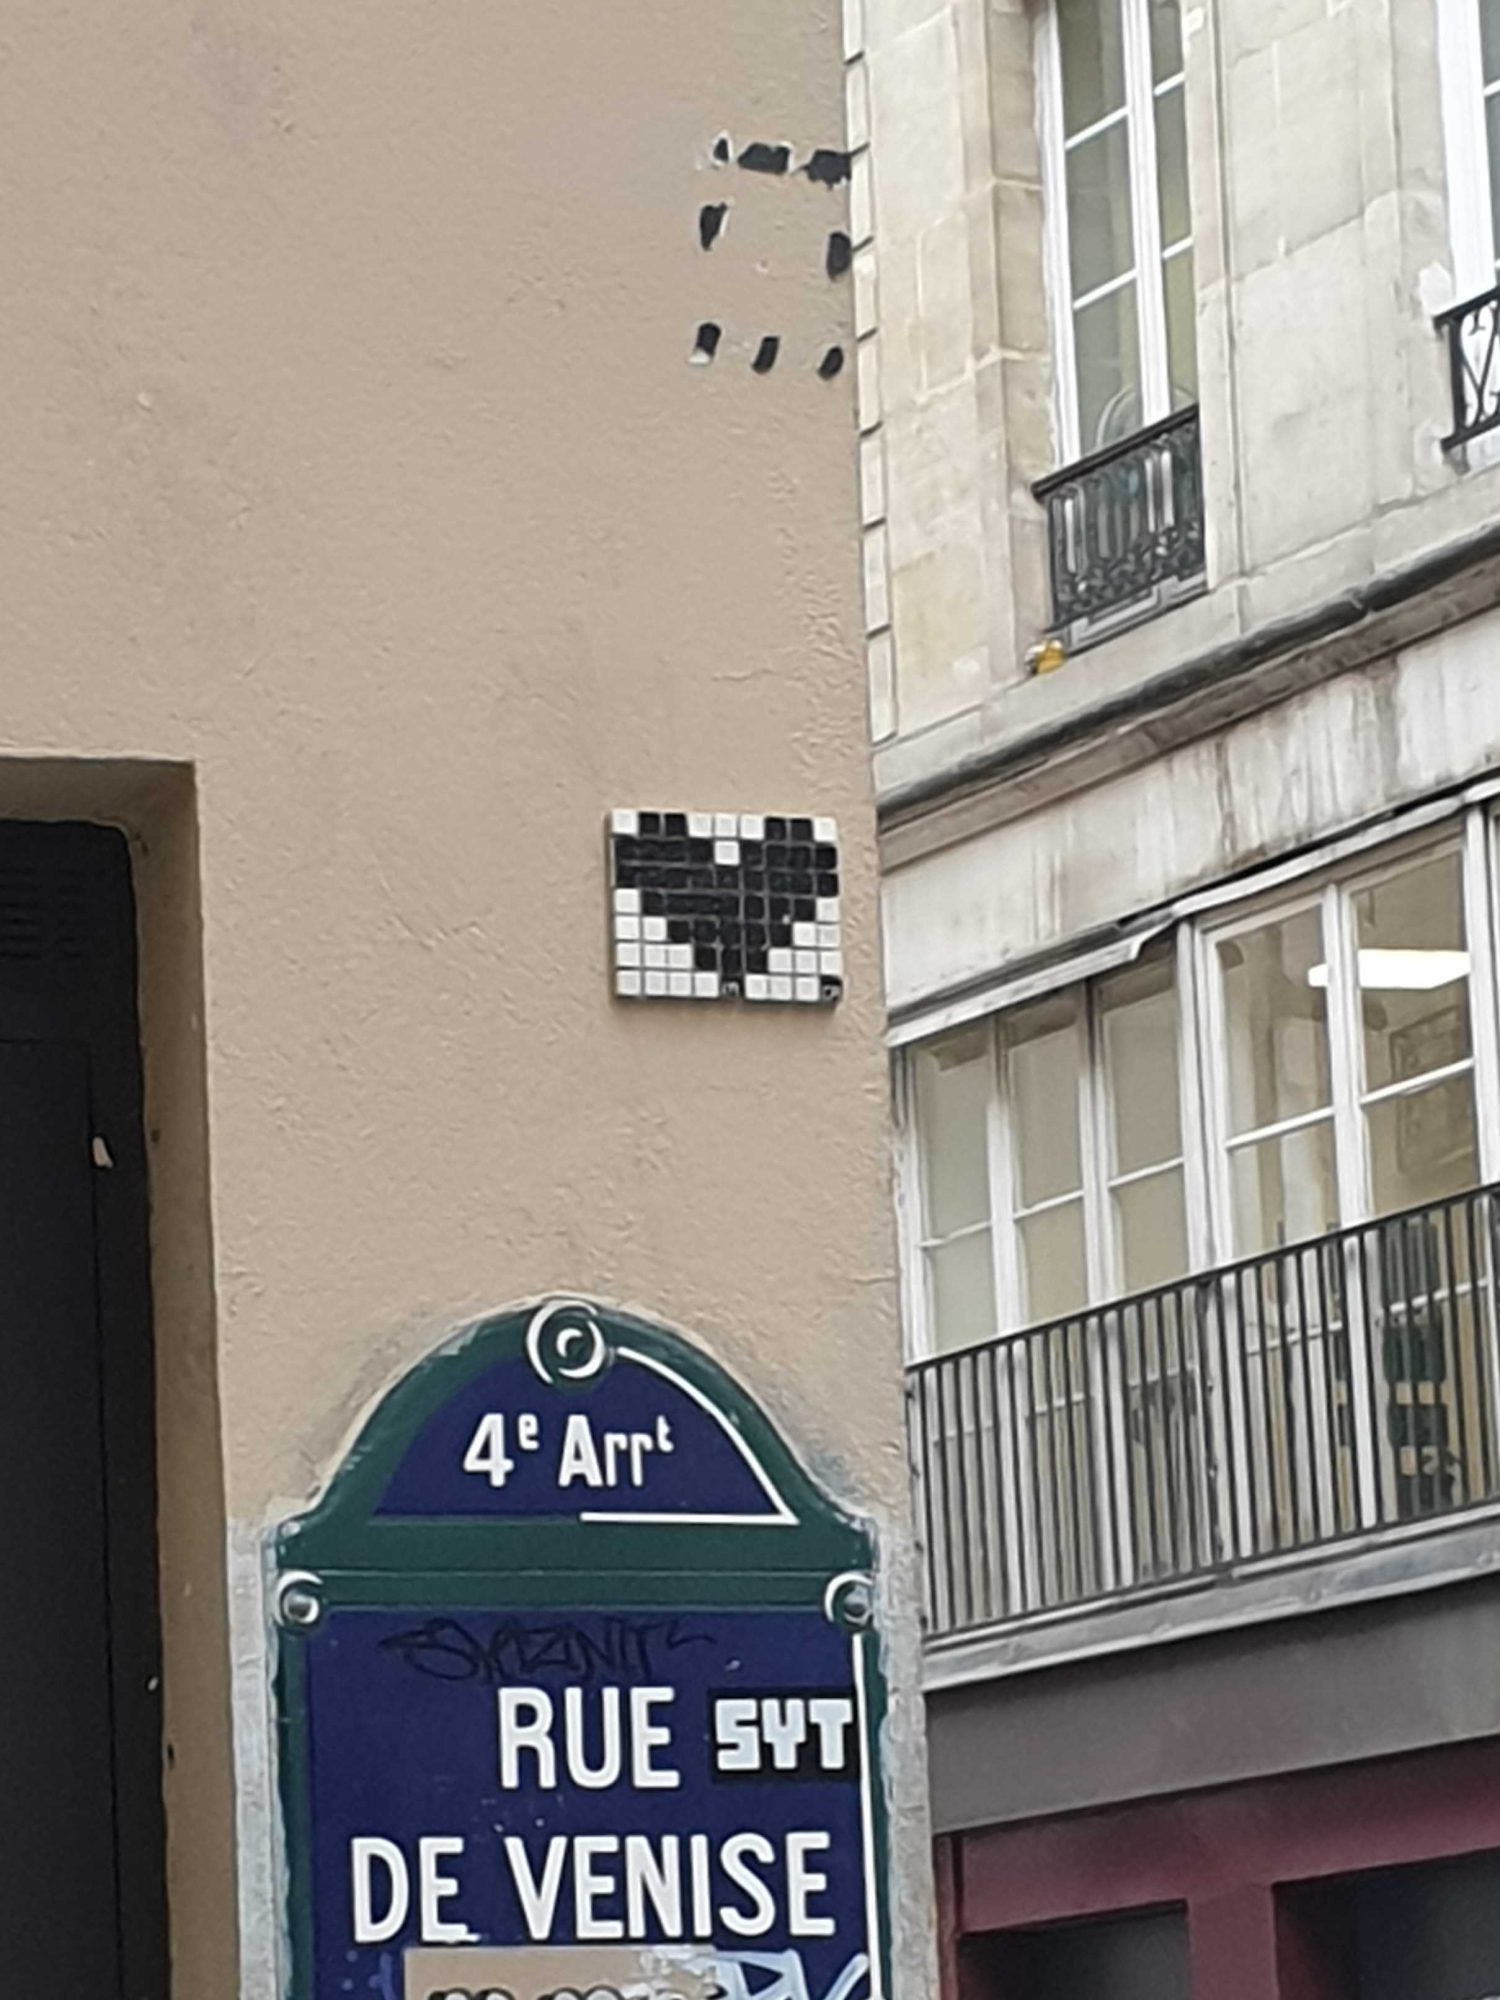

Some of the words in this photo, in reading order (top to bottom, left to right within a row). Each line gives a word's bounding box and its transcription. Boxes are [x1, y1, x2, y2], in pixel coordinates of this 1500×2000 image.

[558, 1414, 674, 1487] Arrt
[498, 1687, 681, 1789] RUE
[714, 1699, 852, 1771] SYT
[351, 1836, 470, 1942] DE
[505, 1832, 835, 1940] VENISE
